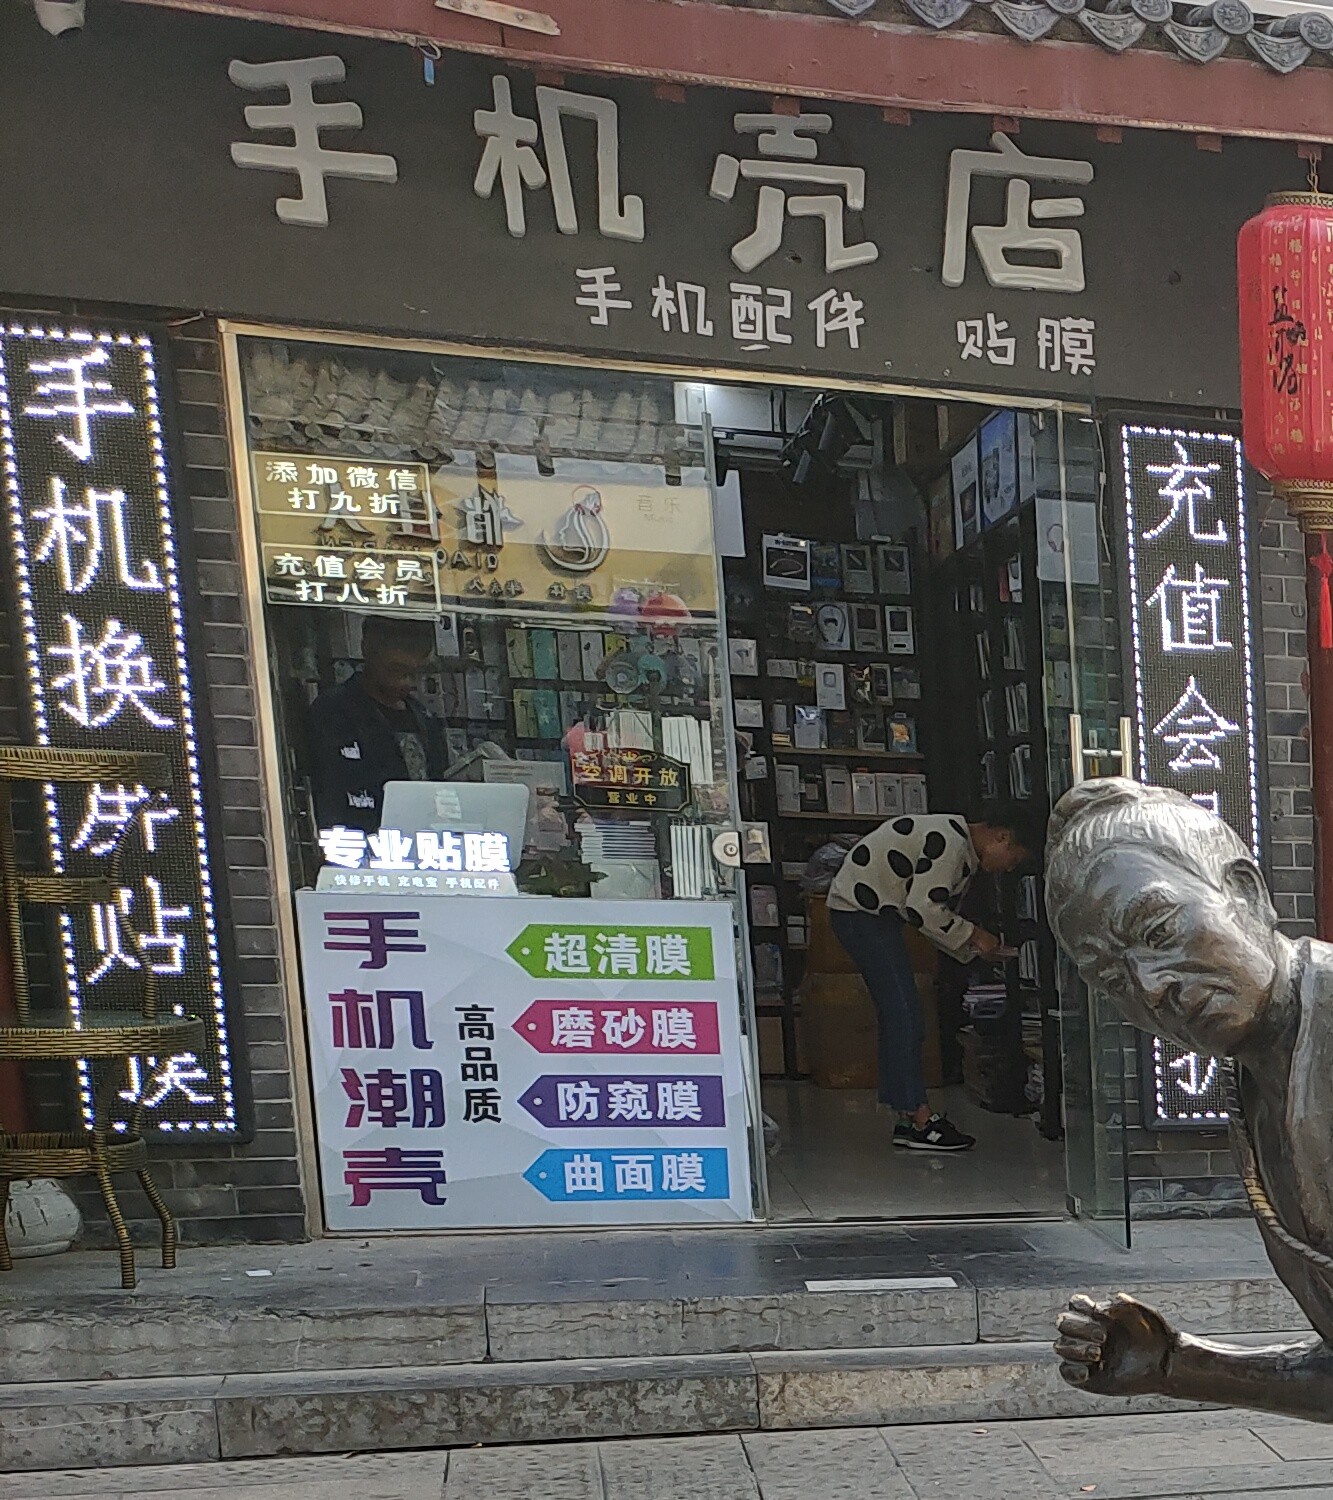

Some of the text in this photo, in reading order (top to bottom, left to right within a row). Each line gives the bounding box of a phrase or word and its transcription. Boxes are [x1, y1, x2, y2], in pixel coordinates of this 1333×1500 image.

[228, 55, 1095, 293] 手机壳店
[575, 267, 1097, 377] 手机配件 贴膜
[265, 461, 418, 491] 添加微信
[287, 487, 401, 515] 打九折
[273, 553, 426, 582] 充值会员
[295, 579, 408, 606] 打八折
[581, 764, 681, 788] 空调开放
[607, 791, 658, 806] 营业中
[319, 825, 511, 873] 专业贴膜
[445, 877, 500, 891] 手机配件
[544, 932, 692, 976] 超清膜
[550, 1006, 698, 1050] 磨砂膜
[323, 911, 448, 1207] 手机潮壳
[454, 1004, 503, 1124] 高品质
[556, 1081, 704, 1123] 防窥膜
[563, 1152, 707, 1194] 曲面膜
